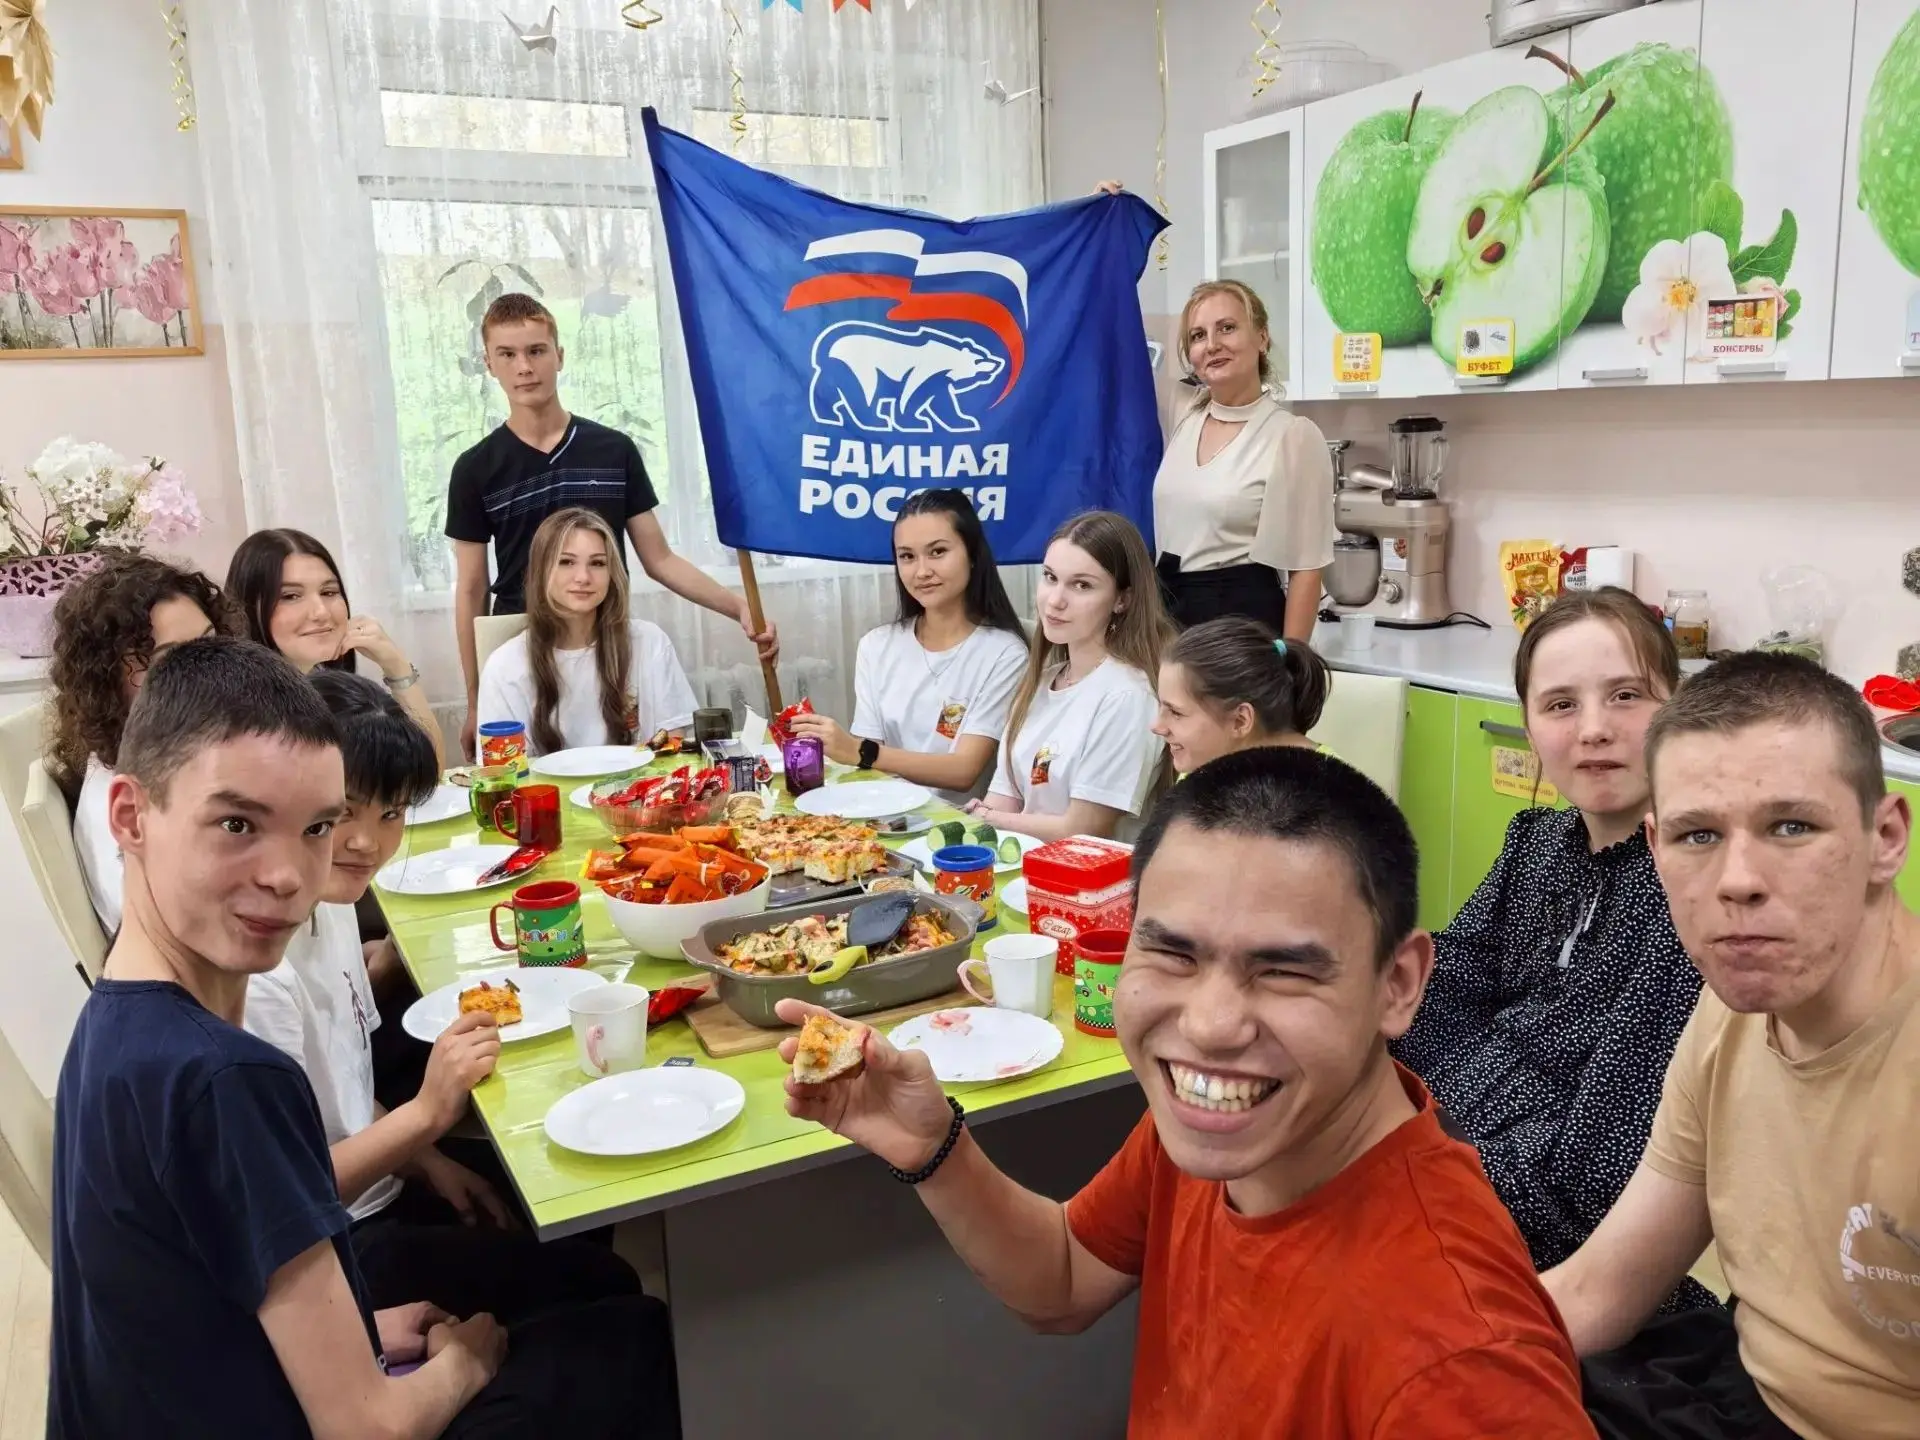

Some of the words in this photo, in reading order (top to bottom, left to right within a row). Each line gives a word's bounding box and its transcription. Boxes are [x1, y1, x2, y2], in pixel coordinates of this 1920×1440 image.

[1713, 344, 1764, 353] КОНСЕРВЫ
[1467, 361, 1502, 372] БУФЕТ
[1342, 372, 1371, 381] БУФЕТ
[802, 434, 1009, 478] ЕДИНАЯ
[800, 479, 1007, 522] РОСЯ
